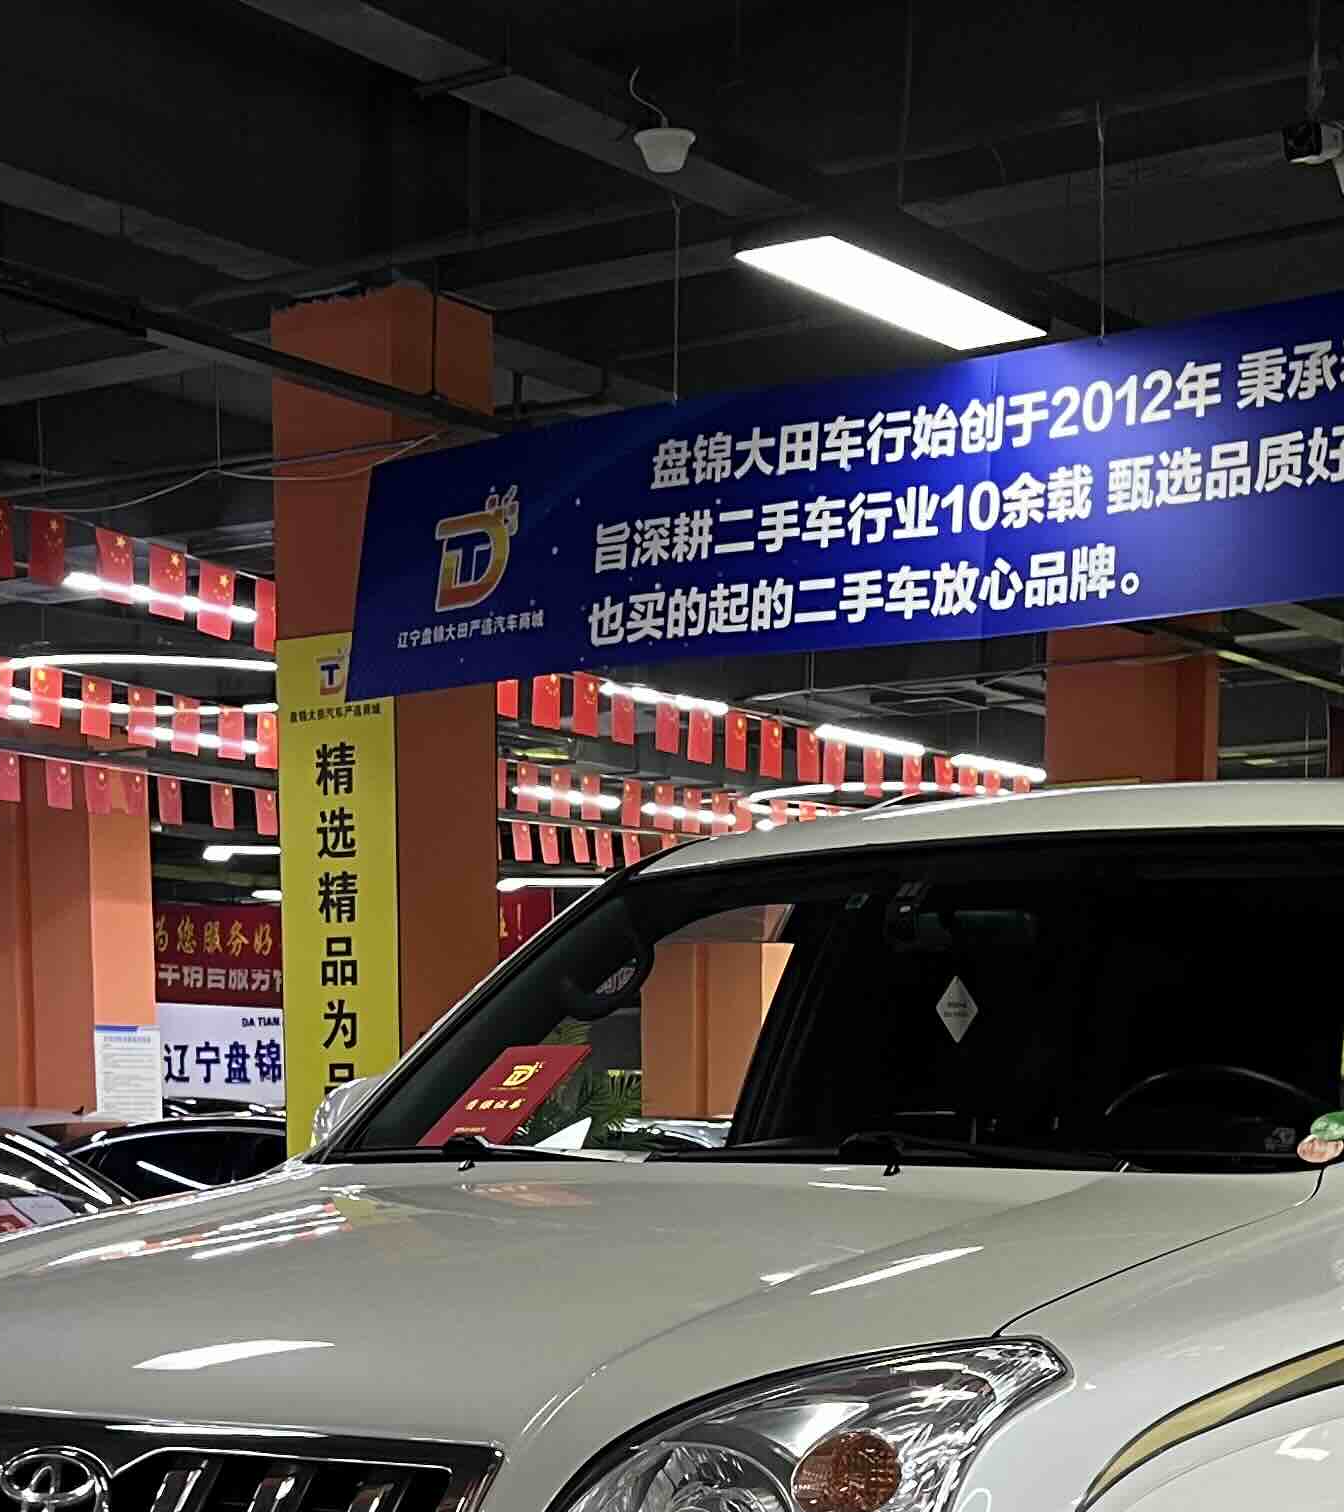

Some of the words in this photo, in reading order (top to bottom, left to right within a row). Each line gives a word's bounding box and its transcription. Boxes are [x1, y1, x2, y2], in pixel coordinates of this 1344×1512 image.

[650, 360, 1222, 490] 盘锦大田车行始创于2012年
[594, 463, 1094, 574] 旨深耕二手车行业10余载
[588, 543, 1140, 648] 也买的起的二手车放心品牌。
[163, 1039, 282, 1085] 辽宁盘锦
